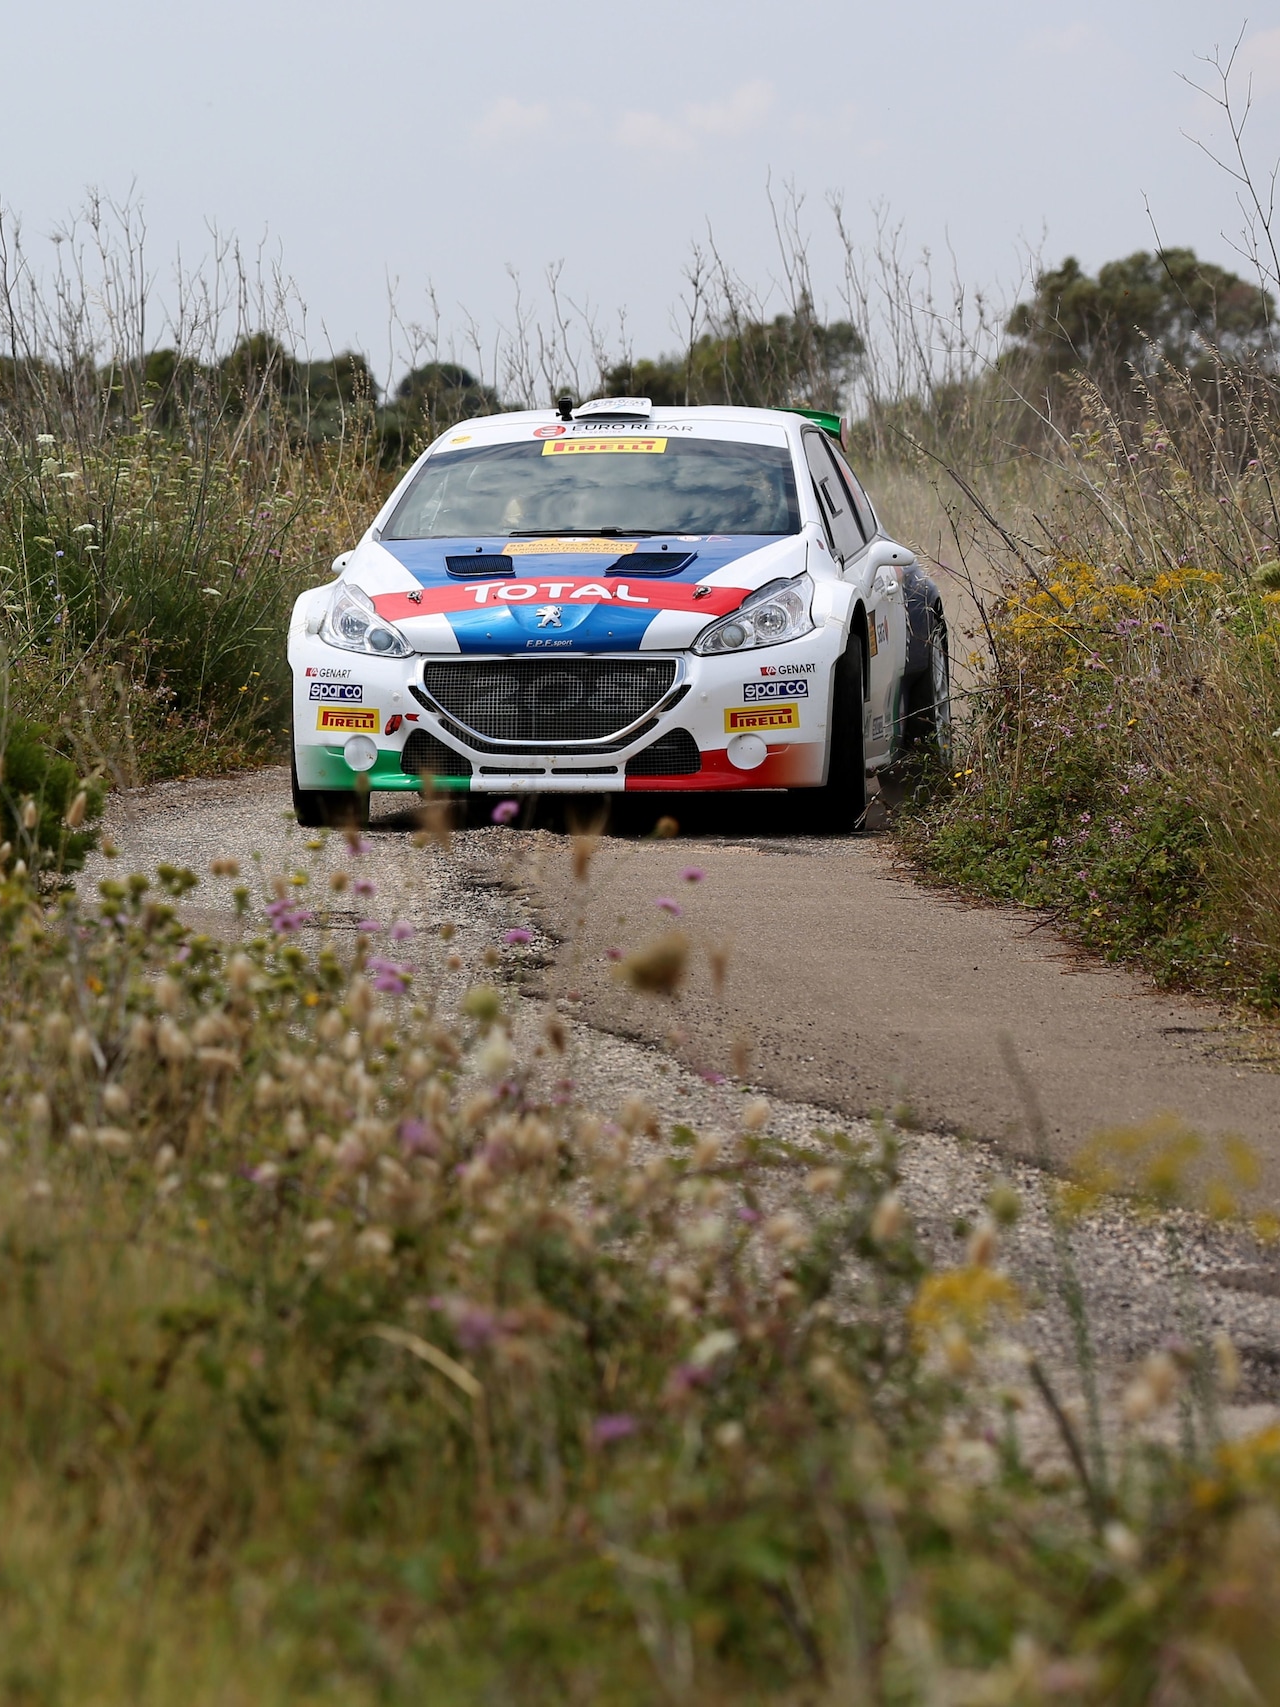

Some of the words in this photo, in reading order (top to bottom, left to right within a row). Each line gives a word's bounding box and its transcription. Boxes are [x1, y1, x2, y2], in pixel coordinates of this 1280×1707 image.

[572, 423, 625, 431] EURO
[630, 423, 693, 432] REPAR
[553, 440, 656, 452] PIRELLI
[464, 582, 649, 604] TOTAL
[320, 668, 352, 678] GENART
[778, 663, 816, 675] GENART
[311, 683, 362, 701] sparco
[744, 681, 807, 701] sparco
[321, 711, 375, 729] PIRELLI
[730, 708, 793, 728] PIRELLI
